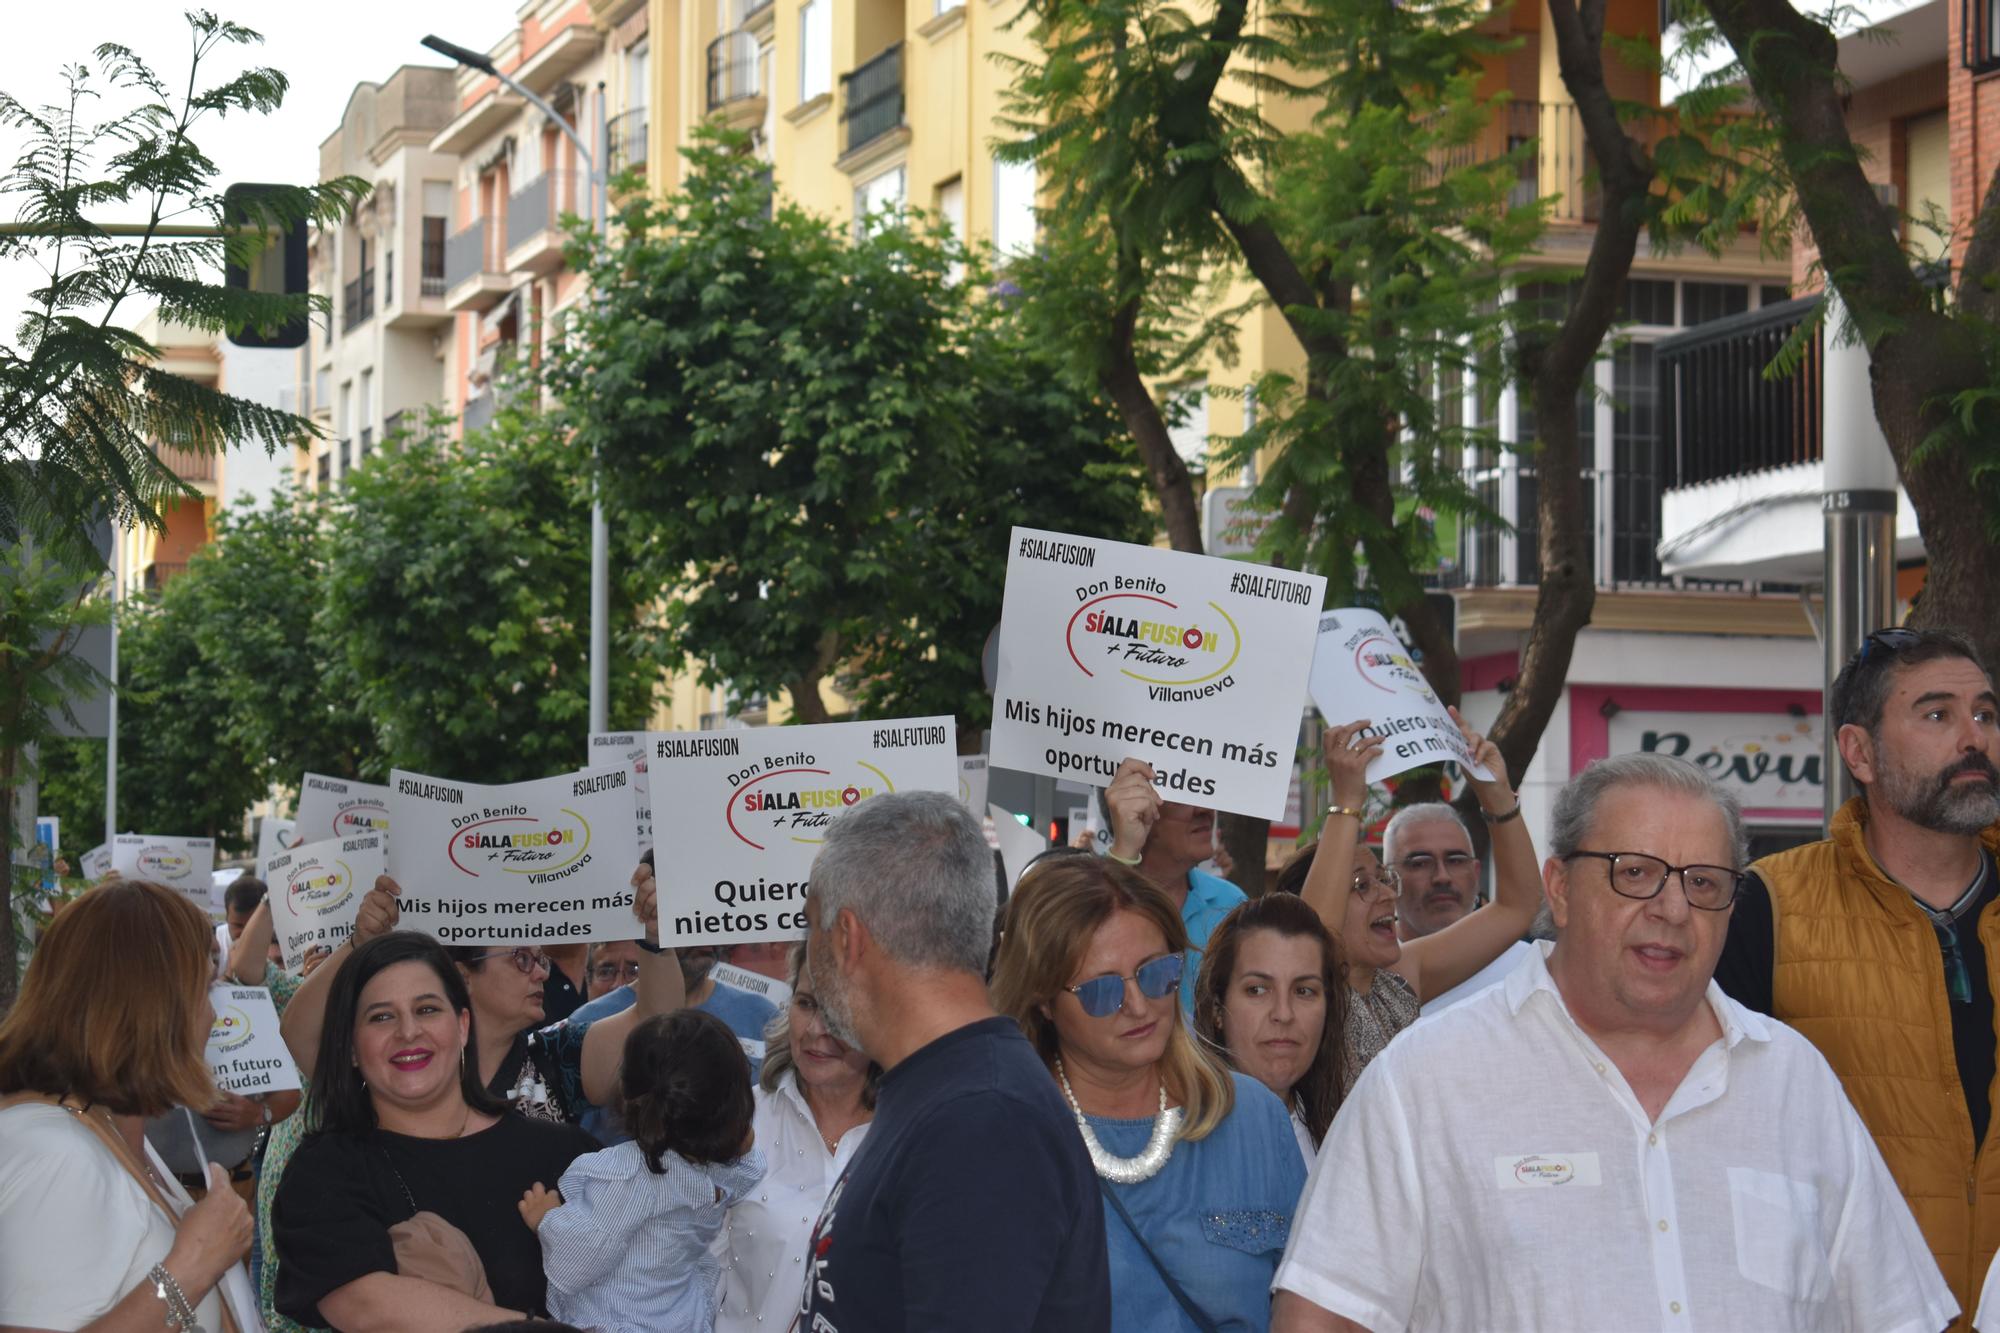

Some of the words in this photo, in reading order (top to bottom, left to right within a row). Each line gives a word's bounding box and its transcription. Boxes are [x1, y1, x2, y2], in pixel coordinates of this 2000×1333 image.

[1020, 538, 1096, 567] #SIALAFUSION
[1076, 579, 1109, 601] Don
[1115, 576, 1167, 595] Benito
[1230, 572, 1312, 606] #SIALFUTURO
[1124, 643, 1190, 668] Futuro
[1148, 675, 1235, 702] Villanueva
[873, 726, 946, 748] #SIALFUTURO
[1005, 699, 1040, 724] Mis
[1046, 705, 1096, 736] hijos
[1102, 718, 1213, 756] merecen
[1222, 742, 1278, 768] más
[657, 738, 739, 758] #SIALAFUSION
[1395, 735, 1423, 758] en
[727, 763, 760, 787] Don
[764, 752, 816, 770] Benito
[1045, 749, 1216, 796] oportuades
[399, 779, 463, 804] #SIALAFUSION
[573, 771, 627, 797] #SIALFUTURO
[451, 813, 480, 829] Don
[483, 805, 527, 818] Benito
[791, 811, 832, 829] Futu
[502, 850, 555, 863] Futuro
[528, 854, 592, 884] Villanueva
[396, 899, 431, 913] Mis
[438, 899, 488, 917] hijos
[493, 896, 585, 914] merecen
[592, 892, 634, 909] más
[438, 922, 592, 941] oportunidades
[675, 911, 768, 935] nietos
[288, 930, 314, 952] Quiero
[317, 928, 326, 939] a
[330, 921, 356, 937] mis
[716, 967, 769, 994] #SIALAFUSION
[232, 1059, 282, 1072] futuro
[217, 1072, 271, 1090] ciudad
